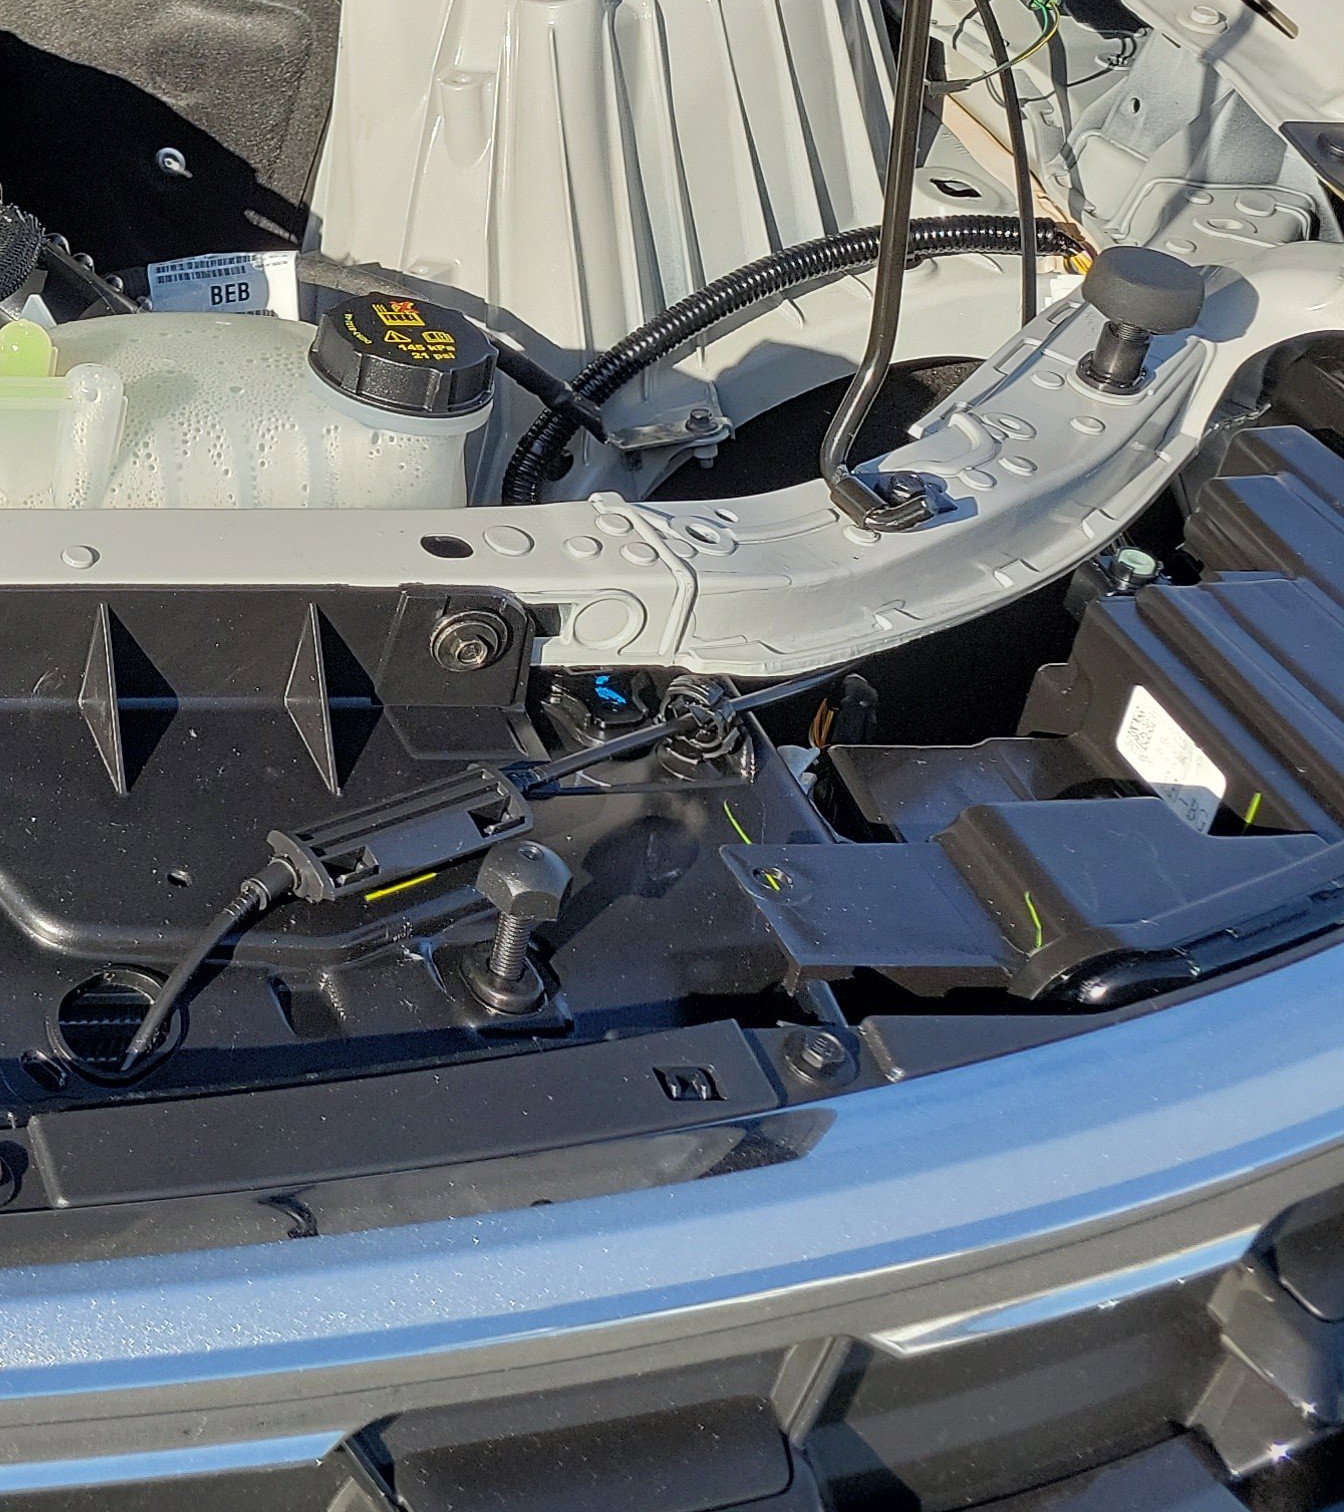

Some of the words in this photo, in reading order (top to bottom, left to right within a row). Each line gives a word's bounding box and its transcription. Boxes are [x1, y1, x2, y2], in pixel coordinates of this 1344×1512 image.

[210, 281, 250, 306] BEB
[398, 344, 426, 352] 145
[428, 344, 456, 352] kPa
[412, 352, 430, 360] 21
[433, 352, 456, 361] psi
